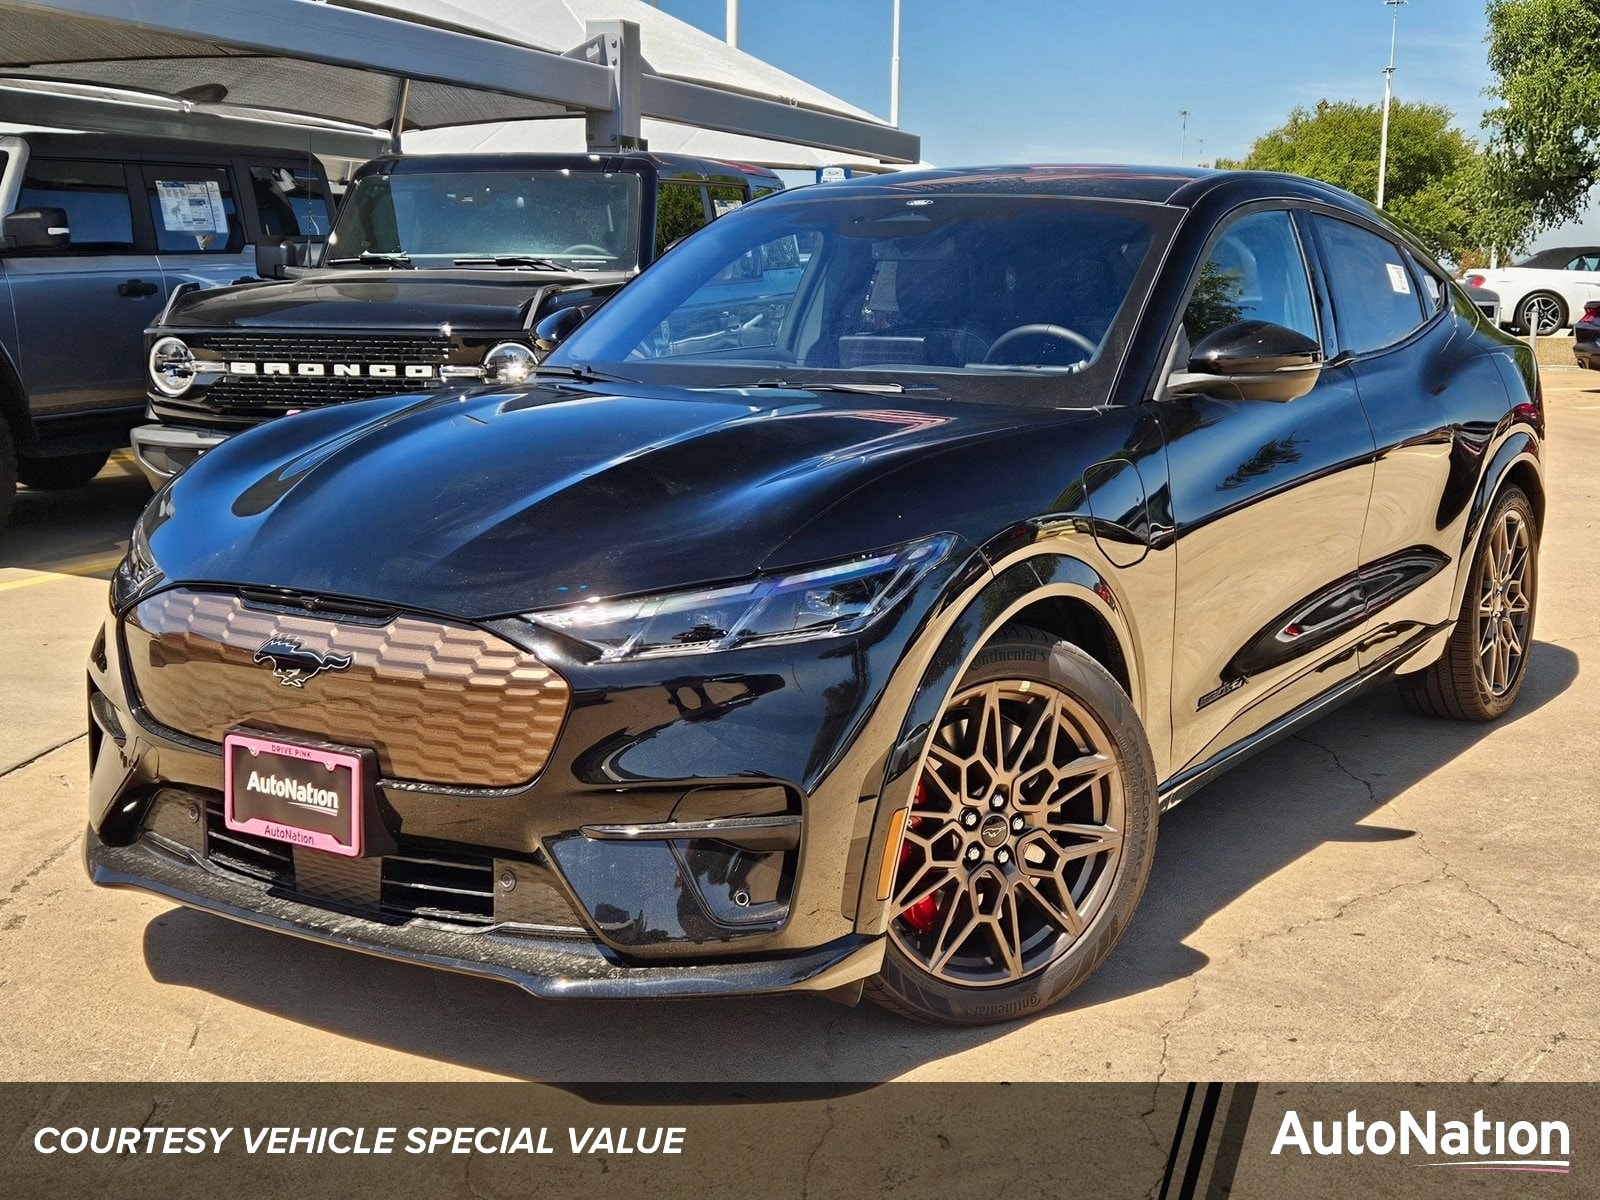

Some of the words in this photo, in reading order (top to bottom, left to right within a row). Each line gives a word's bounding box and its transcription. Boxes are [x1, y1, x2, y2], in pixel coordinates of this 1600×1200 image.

[230, 362, 433, 378] BRONCO
[271, 744, 293, 755] DRIVE
[294, 748, 312, 759] PINK
[247, 770, 339, 809] AutoNation
[264, 825, 315, 844] AutoNation
